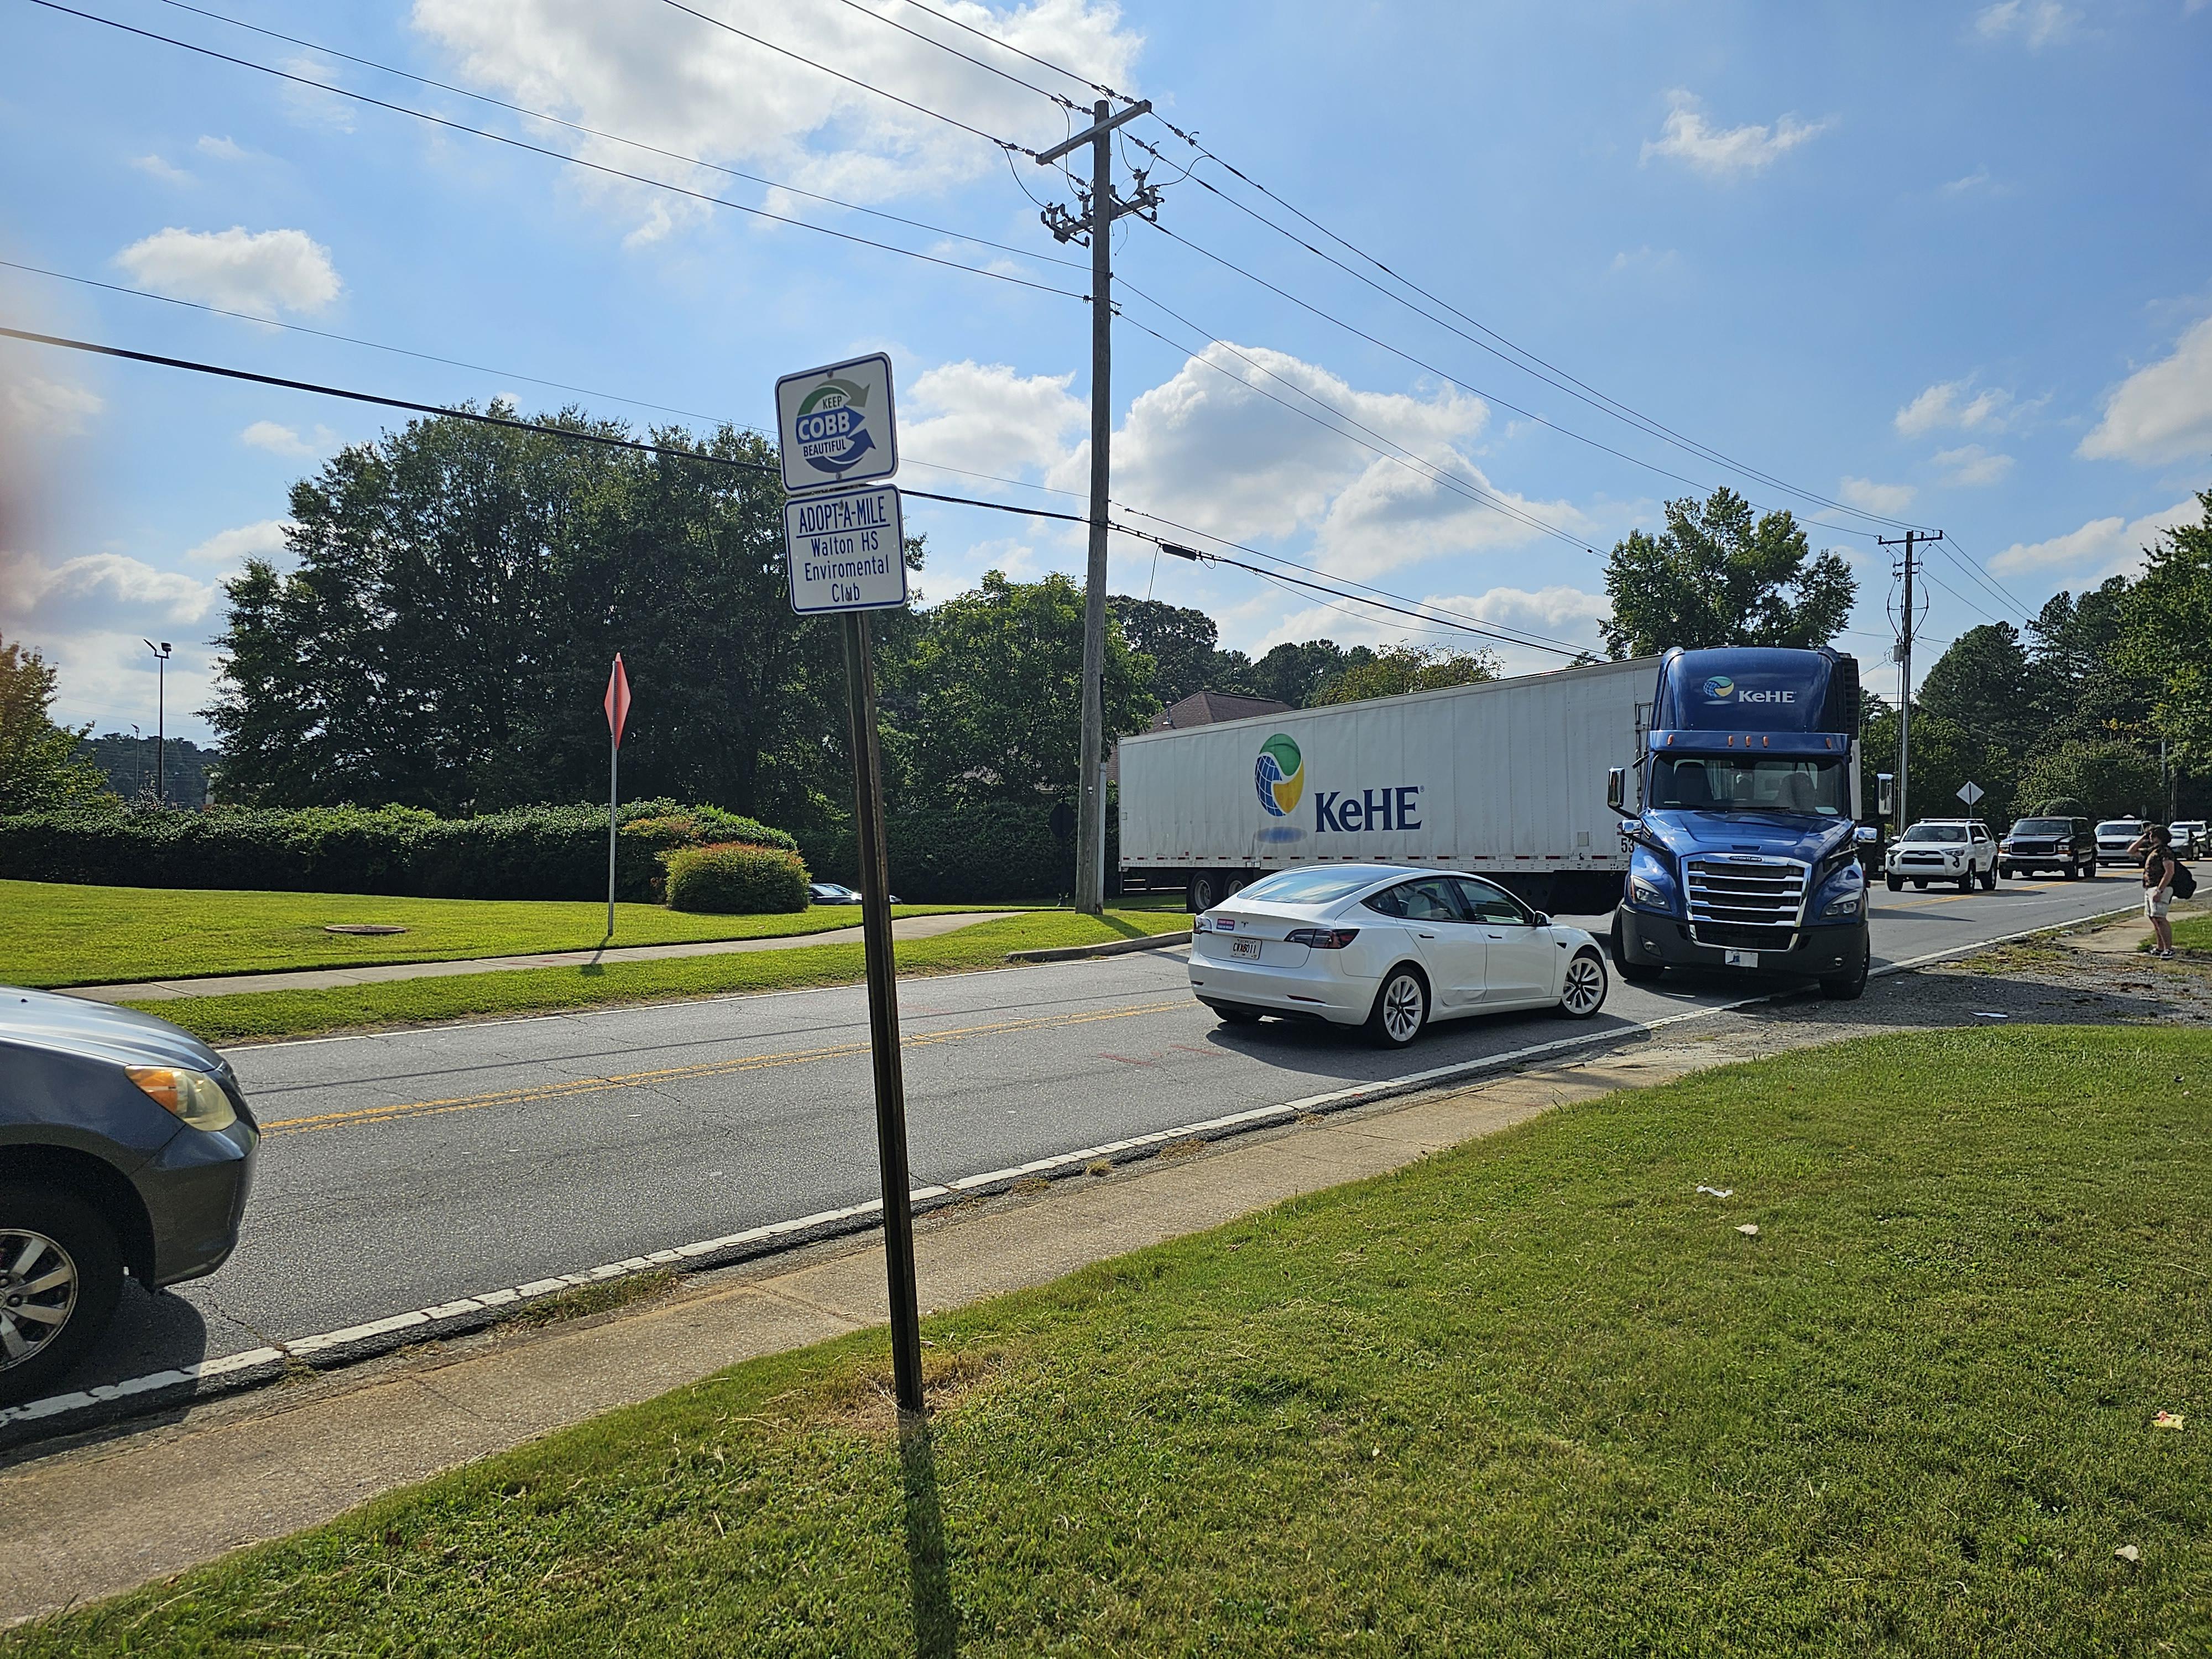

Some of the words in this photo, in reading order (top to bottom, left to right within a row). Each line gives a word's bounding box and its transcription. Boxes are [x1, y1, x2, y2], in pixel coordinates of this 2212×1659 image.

[822, 396, 842, 409] KEEP
[798, 411, 850, 440] COBB
[804, 439, 846, 457] BEAUTIFUL
[800, 496, 886, 533] ADOPT-A-MILE
[811, 536, 853, 557] Walton
[862, 531, 878, 551] HS
[805, 554, 889, 581] Enviromental
